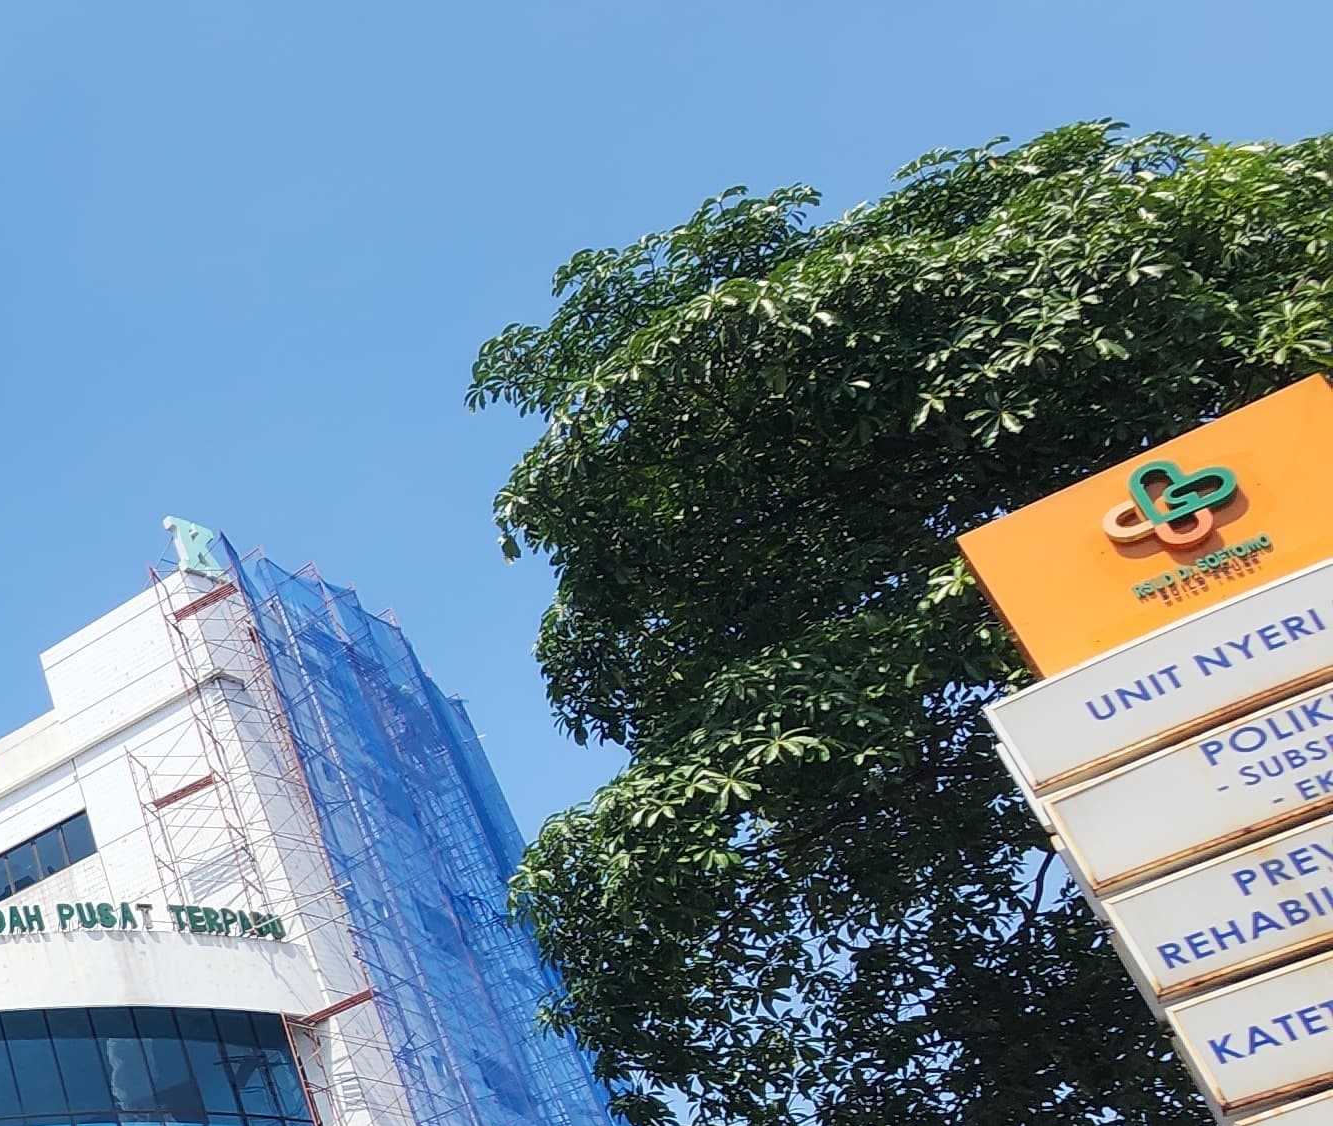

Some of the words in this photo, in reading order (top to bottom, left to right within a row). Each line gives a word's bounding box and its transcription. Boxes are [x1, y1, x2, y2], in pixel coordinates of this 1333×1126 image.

[1085, 665, 1182, 721] UNIT
[1193, 608, 1326, 676] NYERI
[1199, 695, 1333, 766] POLIK
[57, 902, 154, 931] PUSAT
